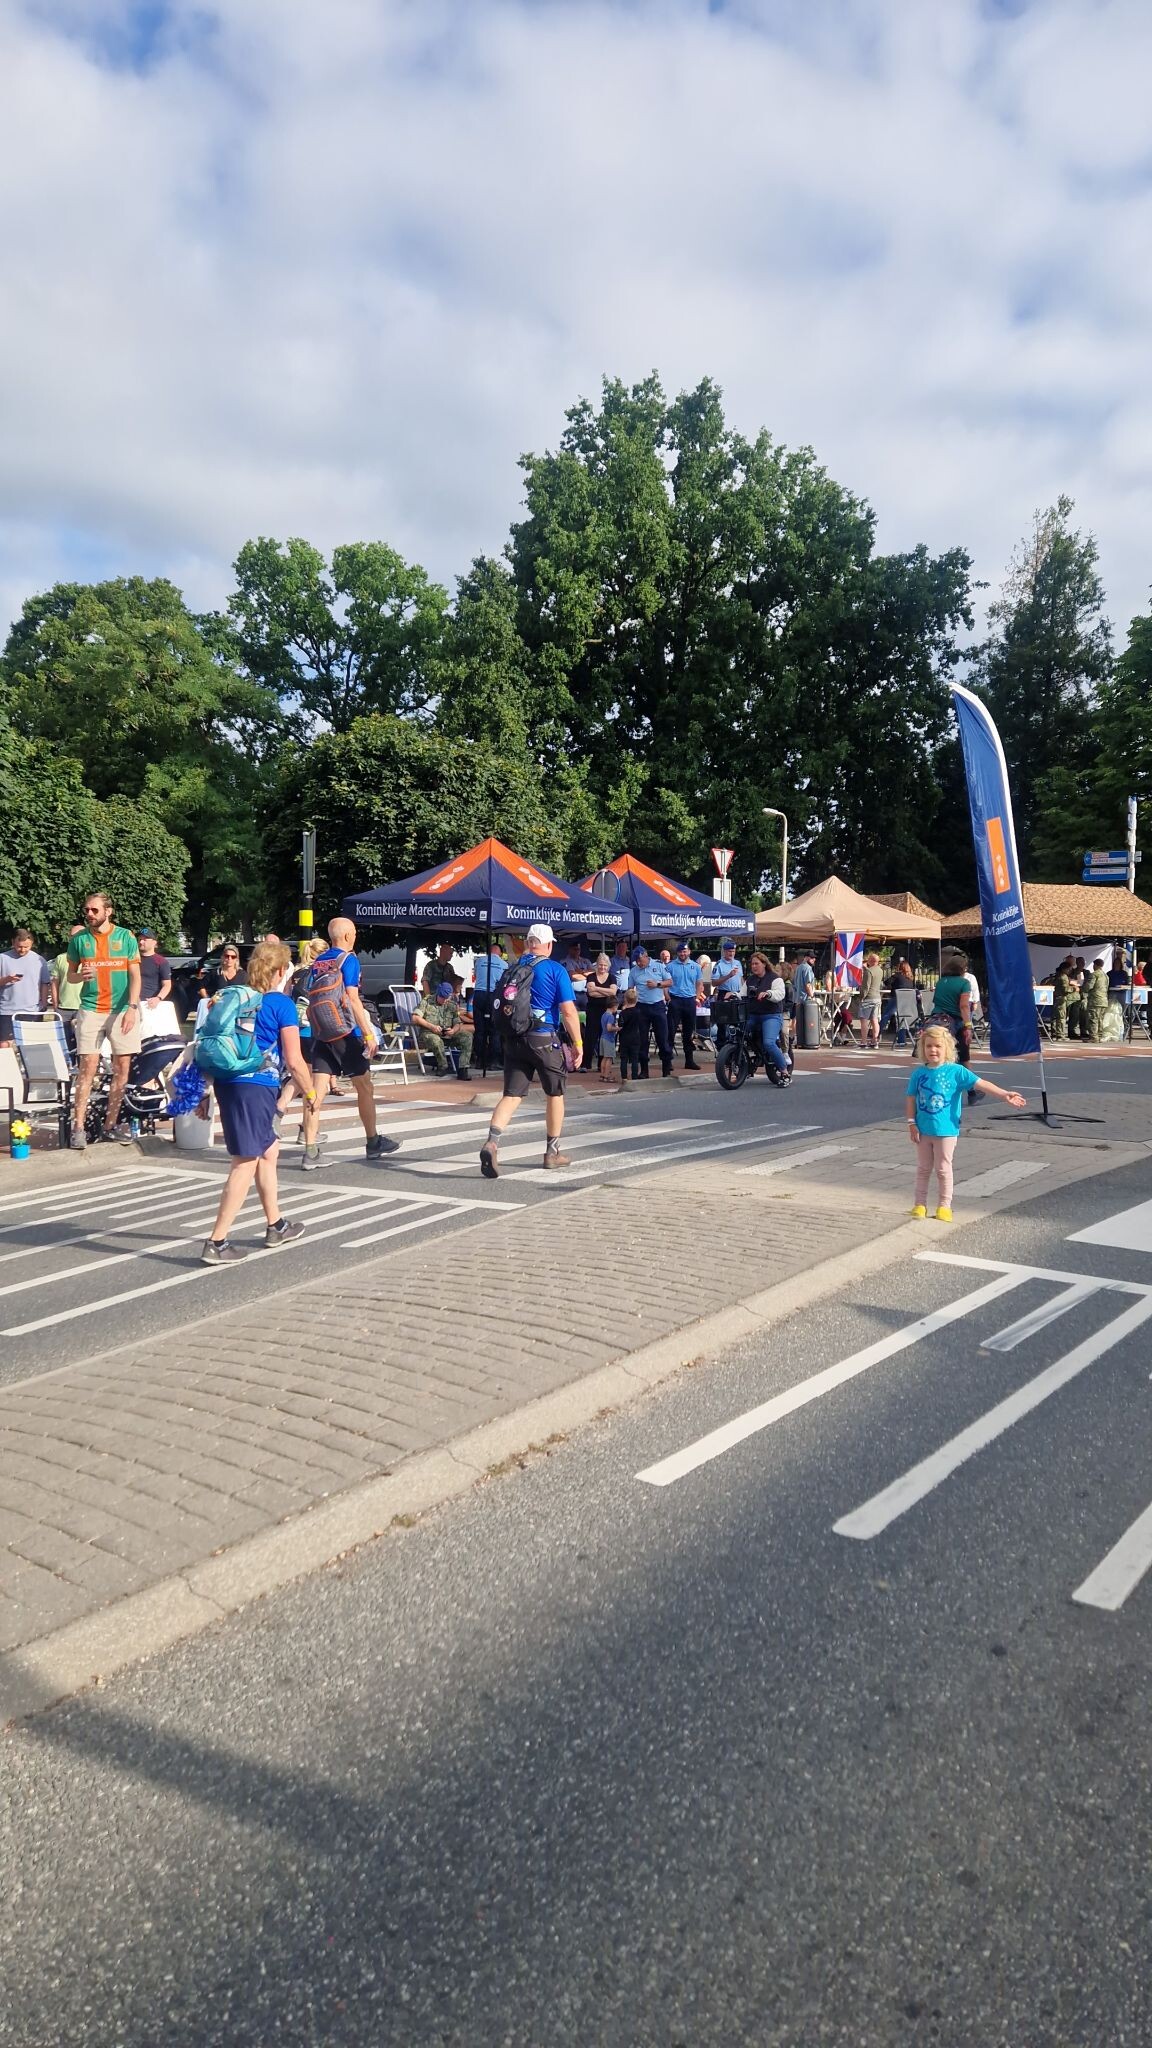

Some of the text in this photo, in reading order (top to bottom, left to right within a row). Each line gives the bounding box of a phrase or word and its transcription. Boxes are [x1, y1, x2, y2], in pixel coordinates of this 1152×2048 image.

[356, 902, 476, 919] Koninklijke Marechaussee
[506, 905, 622, 926] Koninklijke Marechaussee
[651, 914, 746, 929] Koninklijke Marechaussee
